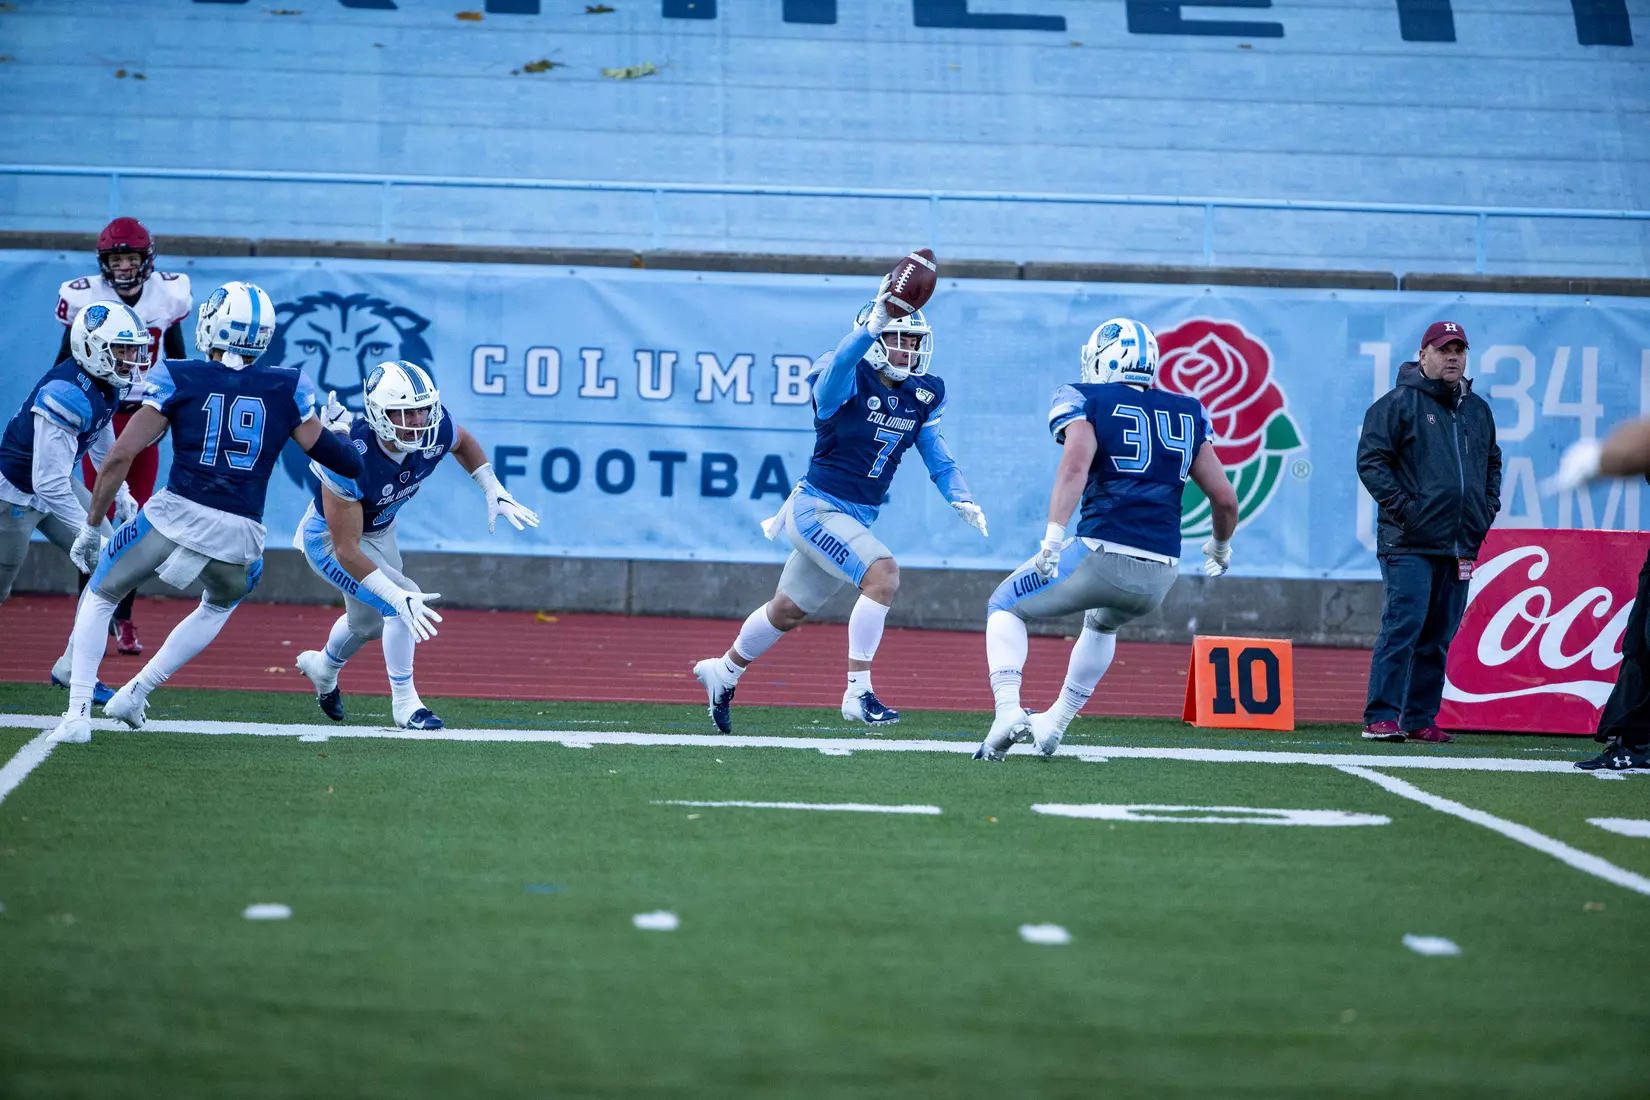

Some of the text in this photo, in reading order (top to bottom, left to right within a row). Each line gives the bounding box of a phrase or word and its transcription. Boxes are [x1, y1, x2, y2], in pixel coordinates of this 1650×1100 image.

[1444, 322, 1458, 332] H
[472, 344, 812, 406] COLUMB
[1358, 341, 1604, 442] 134
[200, 393, 266, 471] 19
[867, 411, 916, 431] COLUMBIA
[1112, 404, 1194, 482] 34
[494, 446, 806, 500] FOOTBA
[868, 429, 904, 478] 7
[107, 521, 138, 559] LIONS
[810, 528, 850, 565] LIONS
[323, 561, 359, 595] LIONS
[1208, 647, 1281, 715] 10
